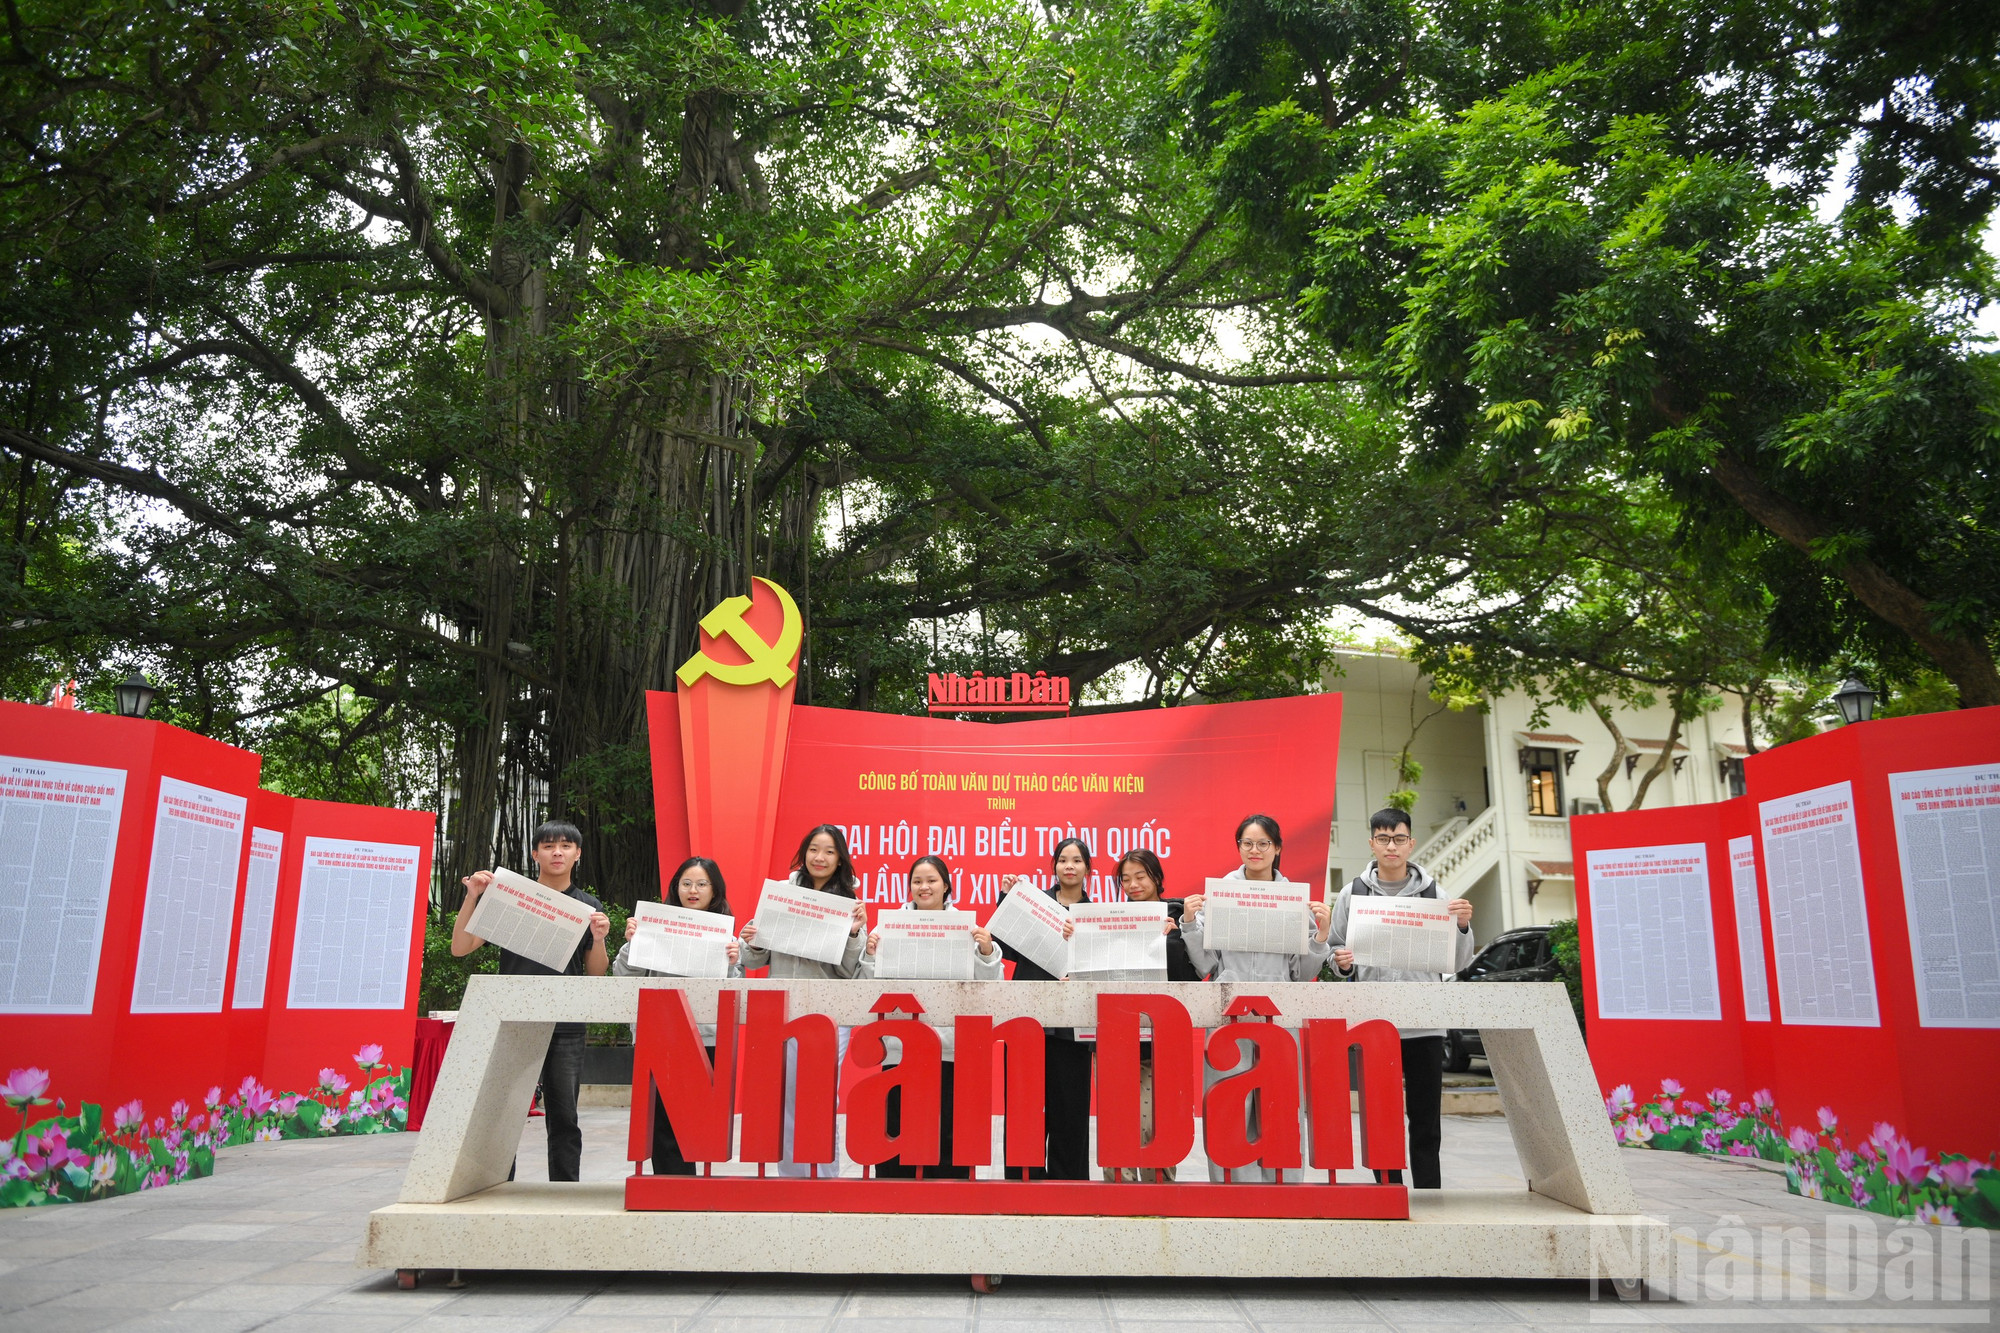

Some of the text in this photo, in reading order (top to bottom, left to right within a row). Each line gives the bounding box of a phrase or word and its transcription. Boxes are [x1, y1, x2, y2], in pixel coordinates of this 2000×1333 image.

[928, 670, 1070, 704] Nhân Dân
[859, 771, 896, 790] CÔNG
[900, 769, 919, 790] BỐ
[921, 771, 956, 791] TOÀN
[961, 772, 987, 791] VĂN
[992, 772, 1010, 793] DỰ
[1052, 773, 1077, 792] CÁC
[1082, 773, 1108, 792] VĂN
[1113, 773, 1144, 794] KIỆN
[987, 796, 1015, 810] TRÌNH
[880, 820, 918, 859] HỘI
[927, 826, 965, 860] ĐẠI
[975, 817, 1026, 857] BIỂU
[863, 864, 908, 903] LẦN
[626, 988, 1408, 1170] Nhân Dân
